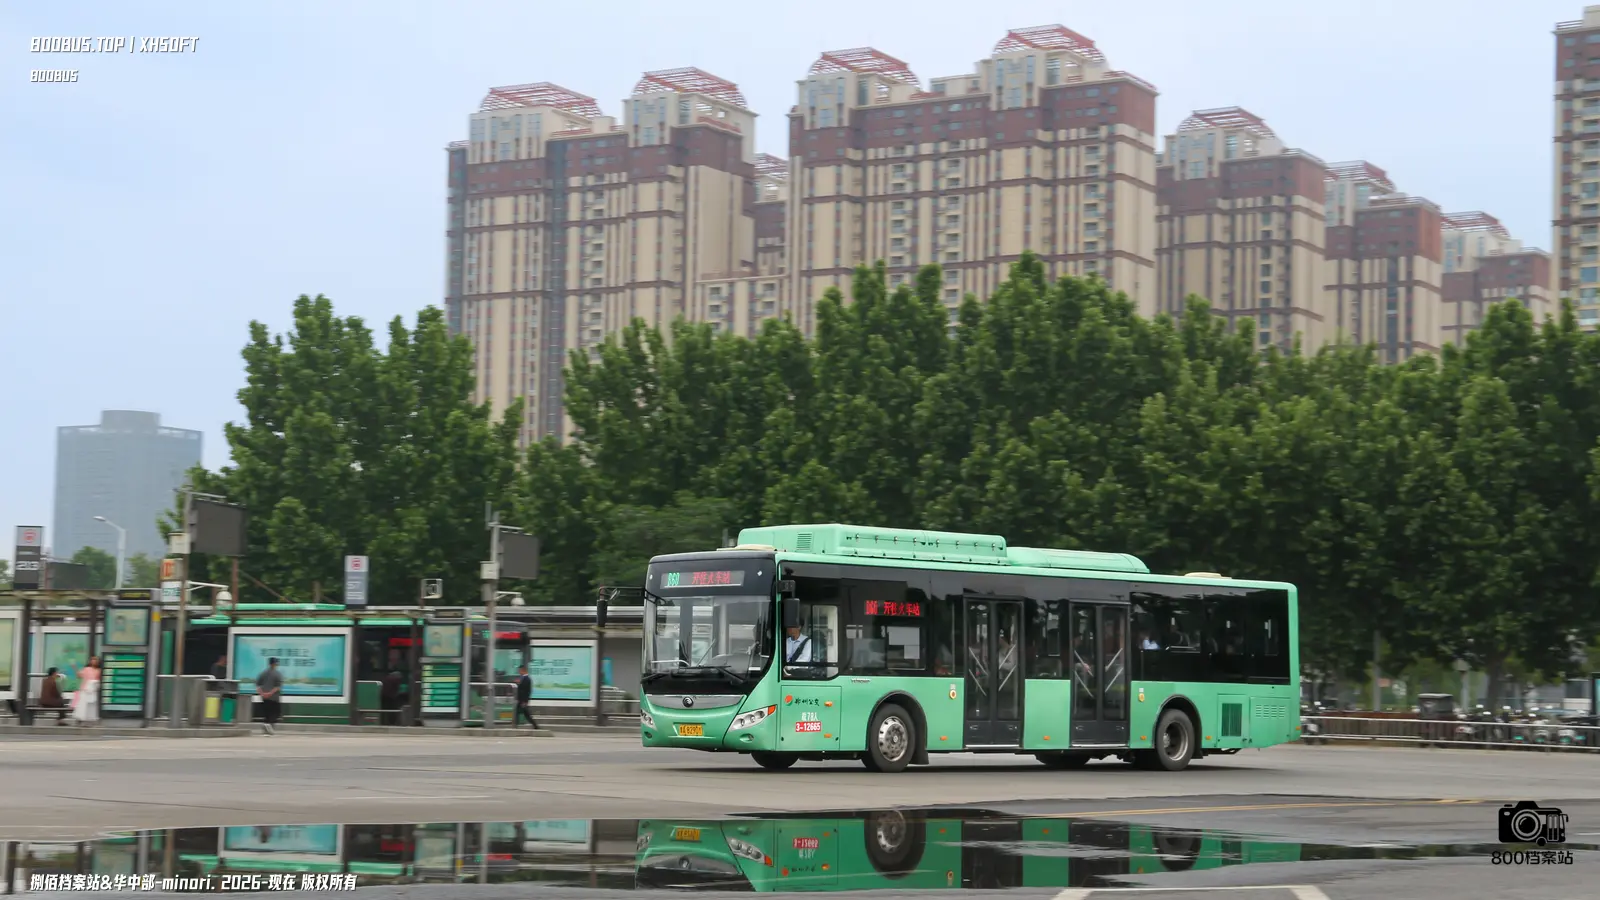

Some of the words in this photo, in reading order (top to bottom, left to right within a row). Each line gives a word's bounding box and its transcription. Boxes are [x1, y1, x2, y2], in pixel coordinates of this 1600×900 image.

[691, 571, 731, 585] 开往火车站
[884, 601, 921, 617] 开往火车站
[794, 697, 820, 707] 郑州公交
[796, 722, 821, 732] 3-12665
